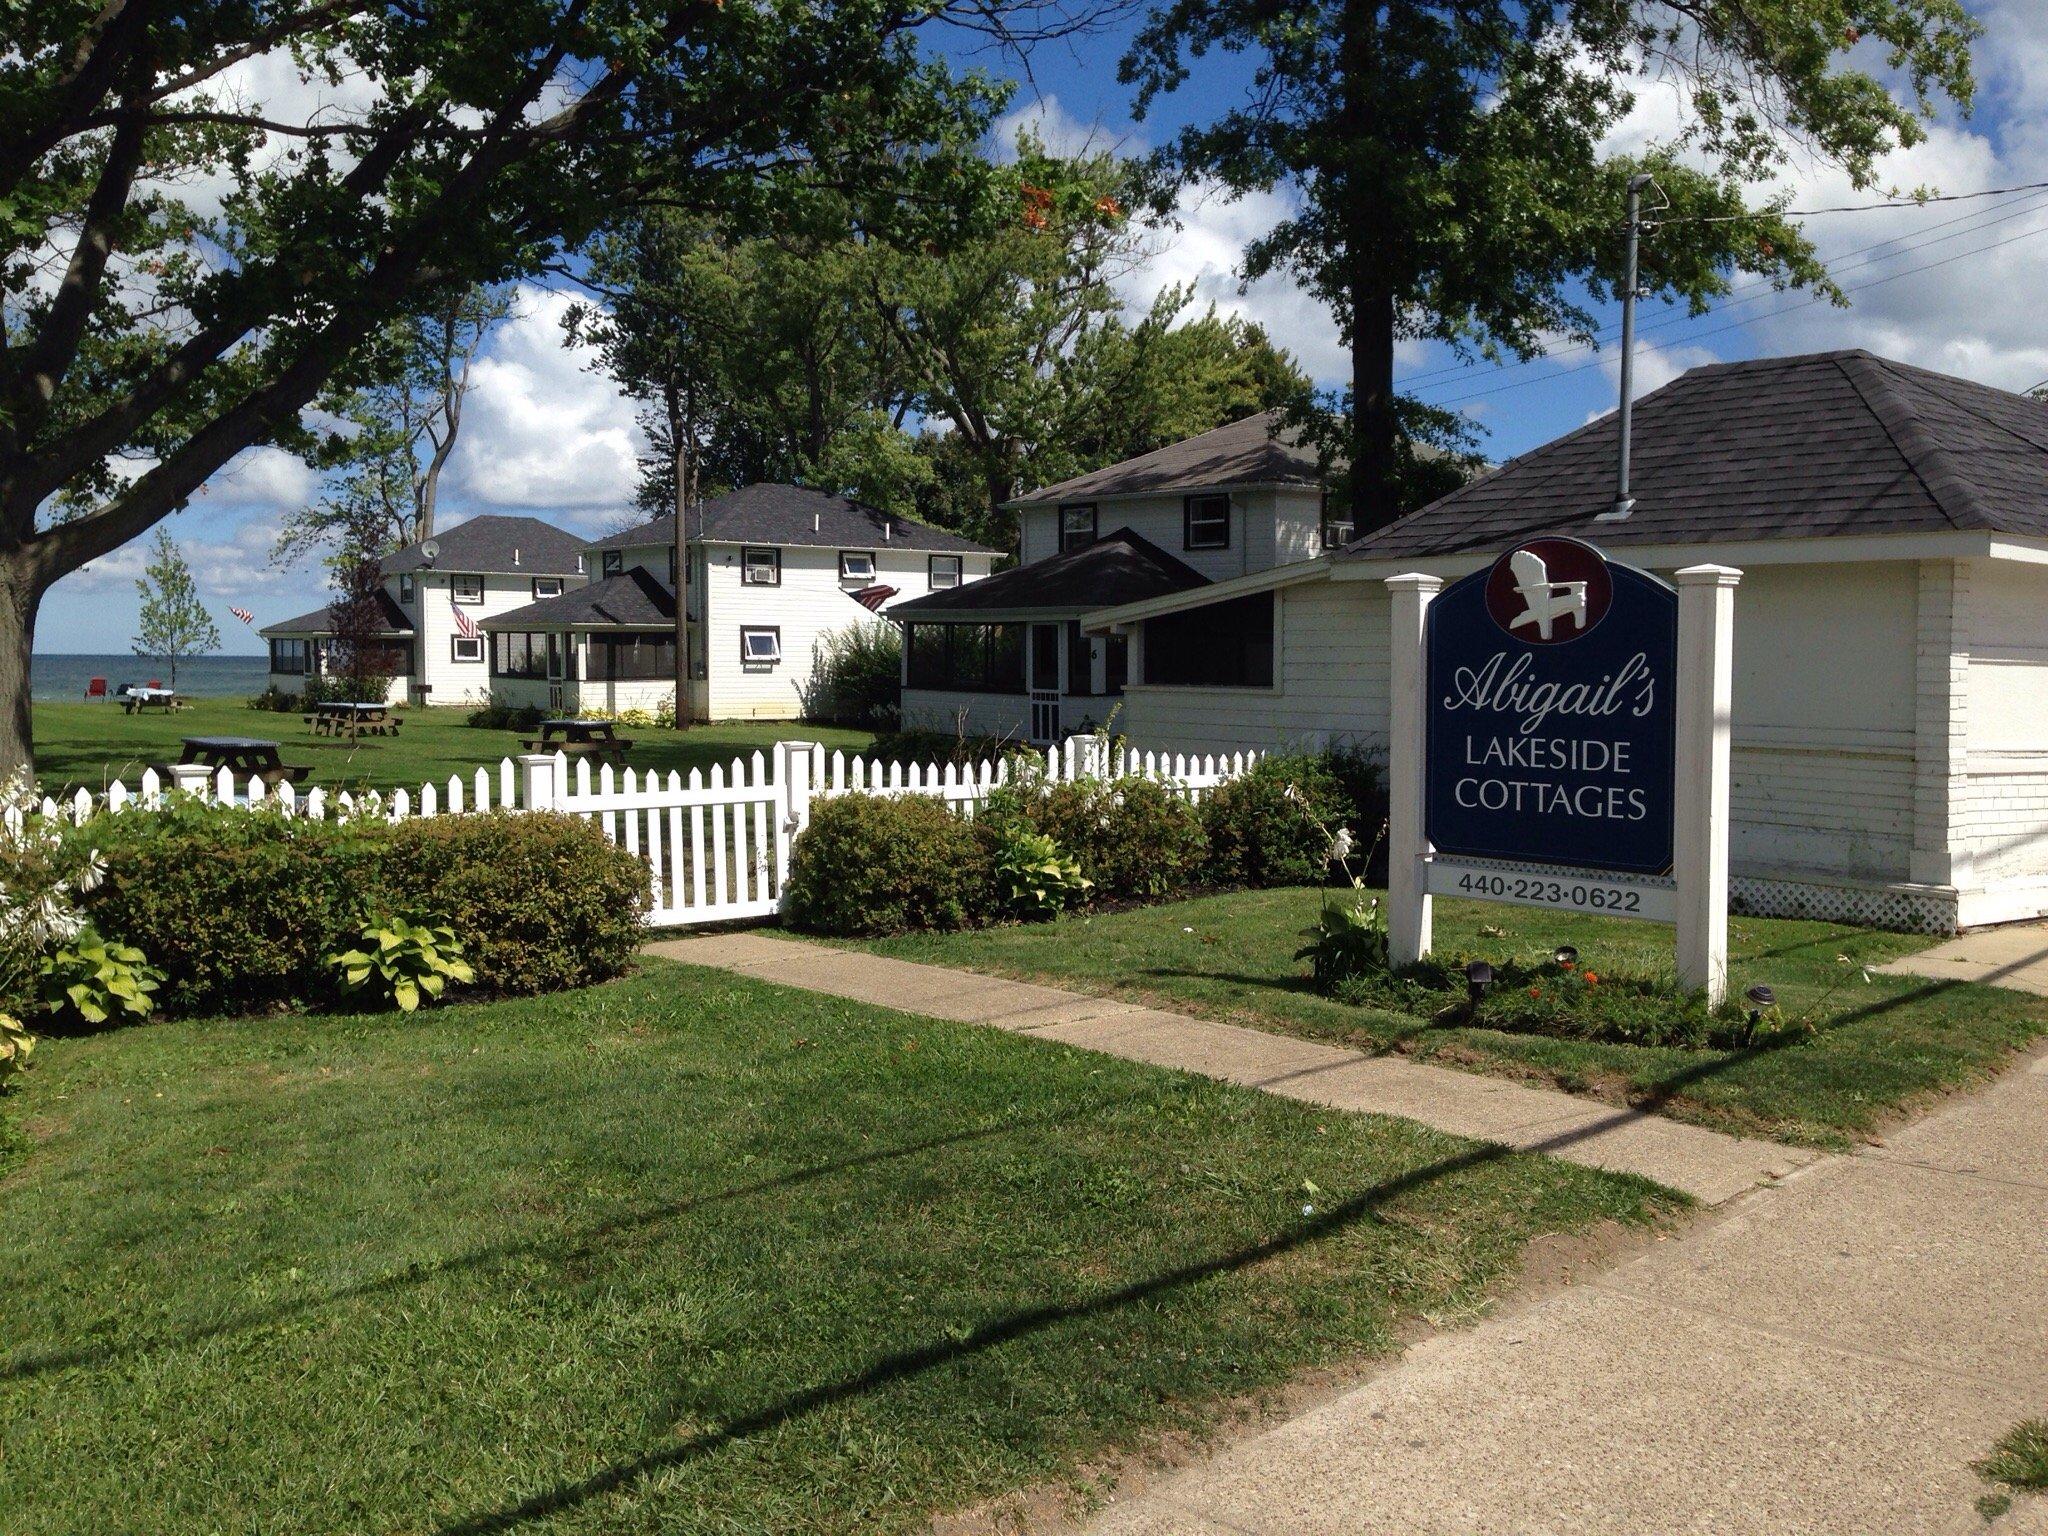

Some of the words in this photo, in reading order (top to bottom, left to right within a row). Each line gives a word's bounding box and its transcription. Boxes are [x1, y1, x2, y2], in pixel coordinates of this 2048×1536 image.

[1443, 651, 1655, 735] Abigail's
[1466, 735, 1631, 773] LAKESIDE
[1455, 778, 1647, 820] COTTAGES
